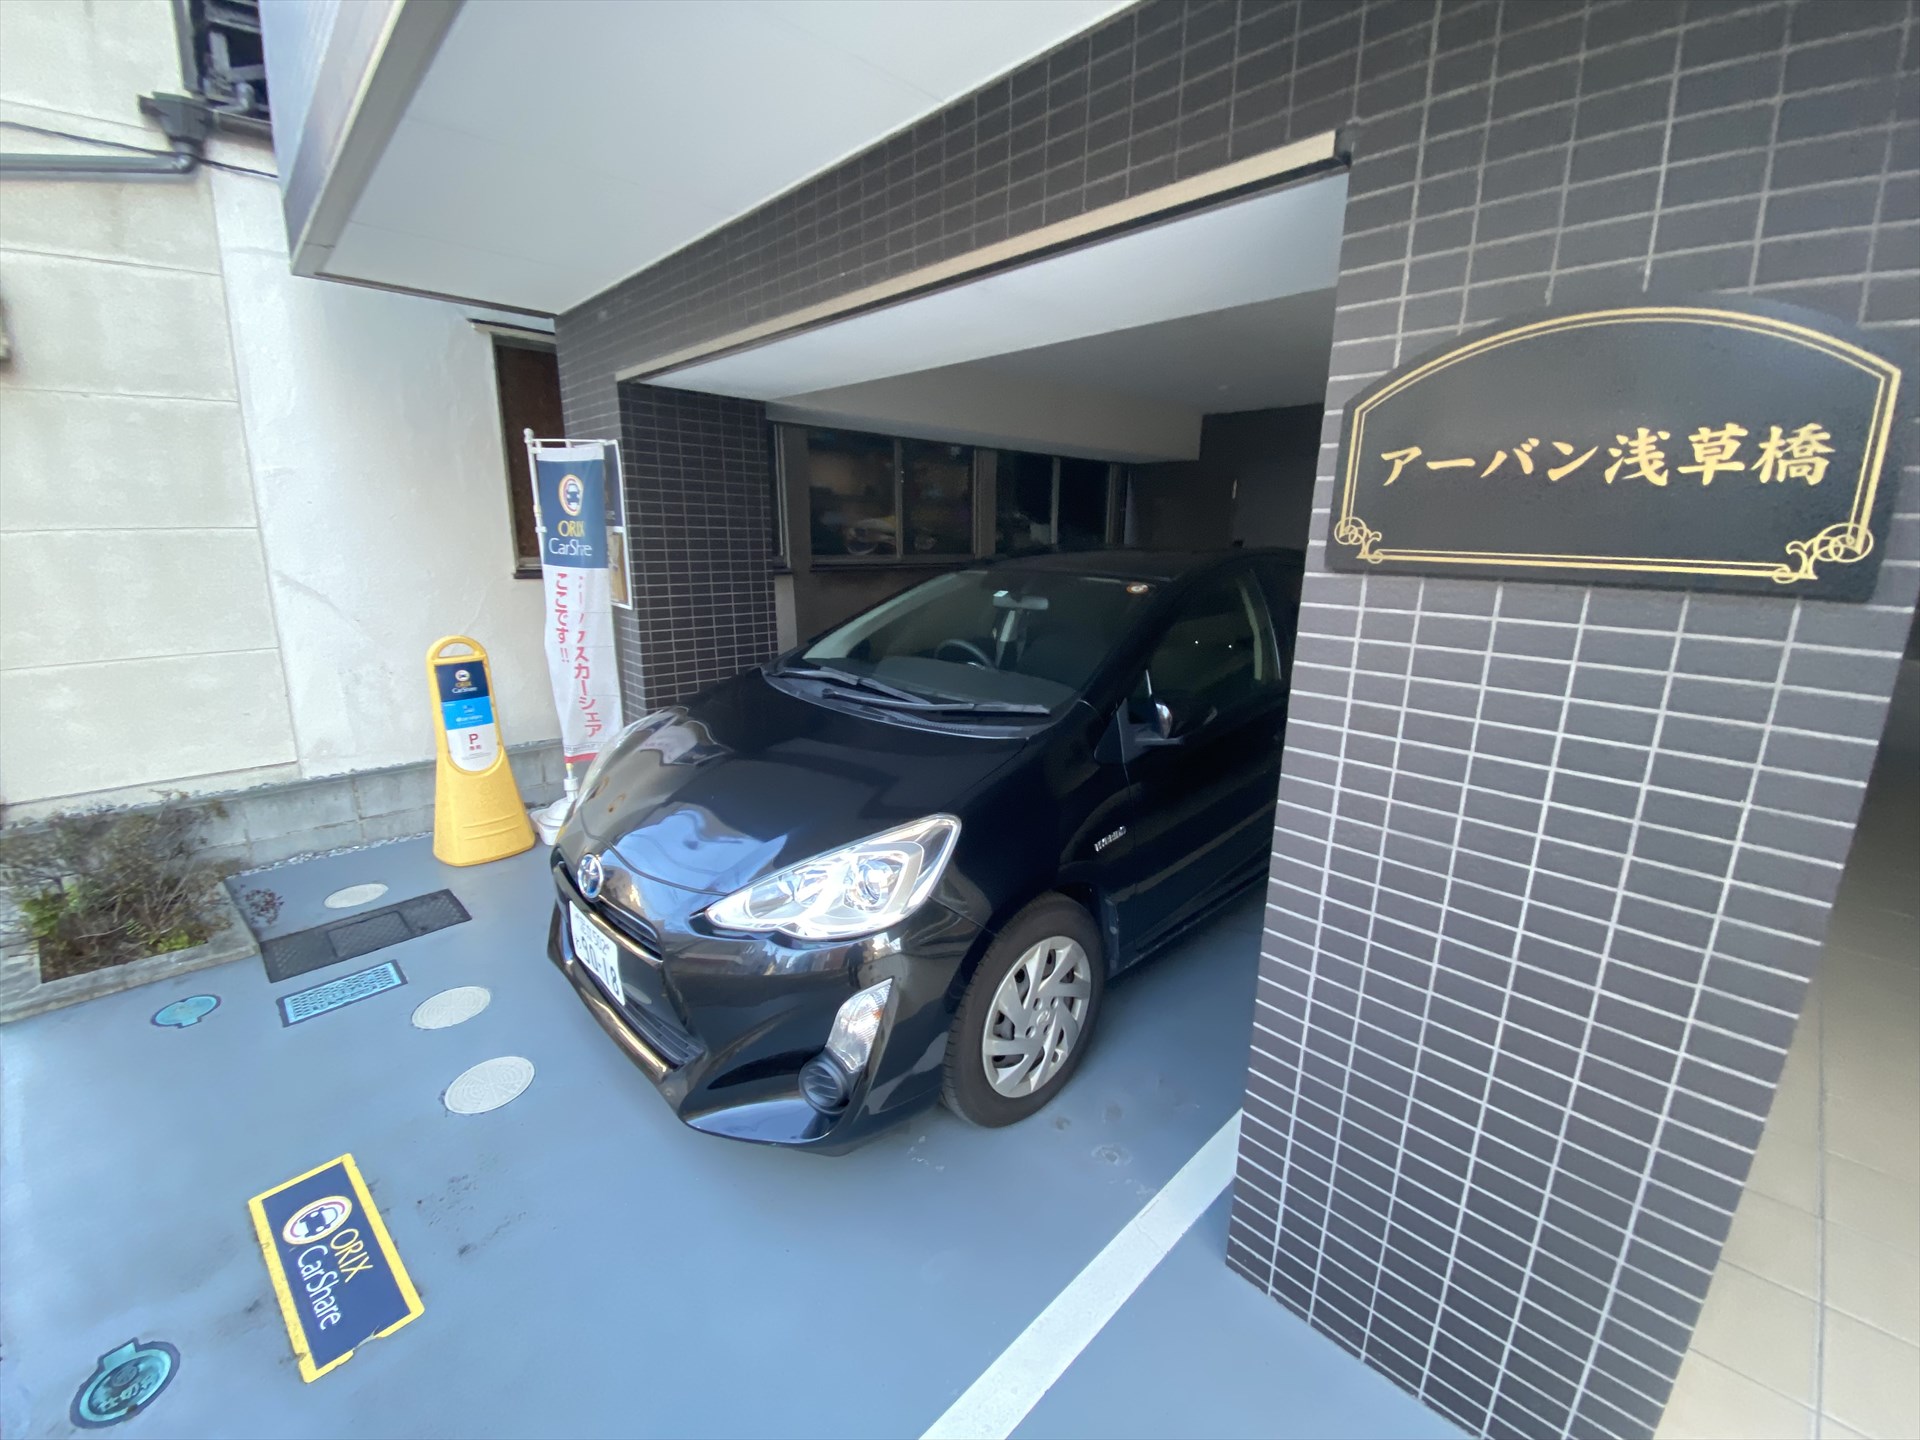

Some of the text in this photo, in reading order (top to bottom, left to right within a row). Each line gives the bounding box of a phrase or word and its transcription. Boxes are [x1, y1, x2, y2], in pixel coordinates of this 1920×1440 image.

[1381, 422, 1836, 487] アーバン浅草橋
[469, 734, 478, 744] P
[330, 1228, 374, 1283] ORIX
[297, 1244, 342, 1331] CarShare
